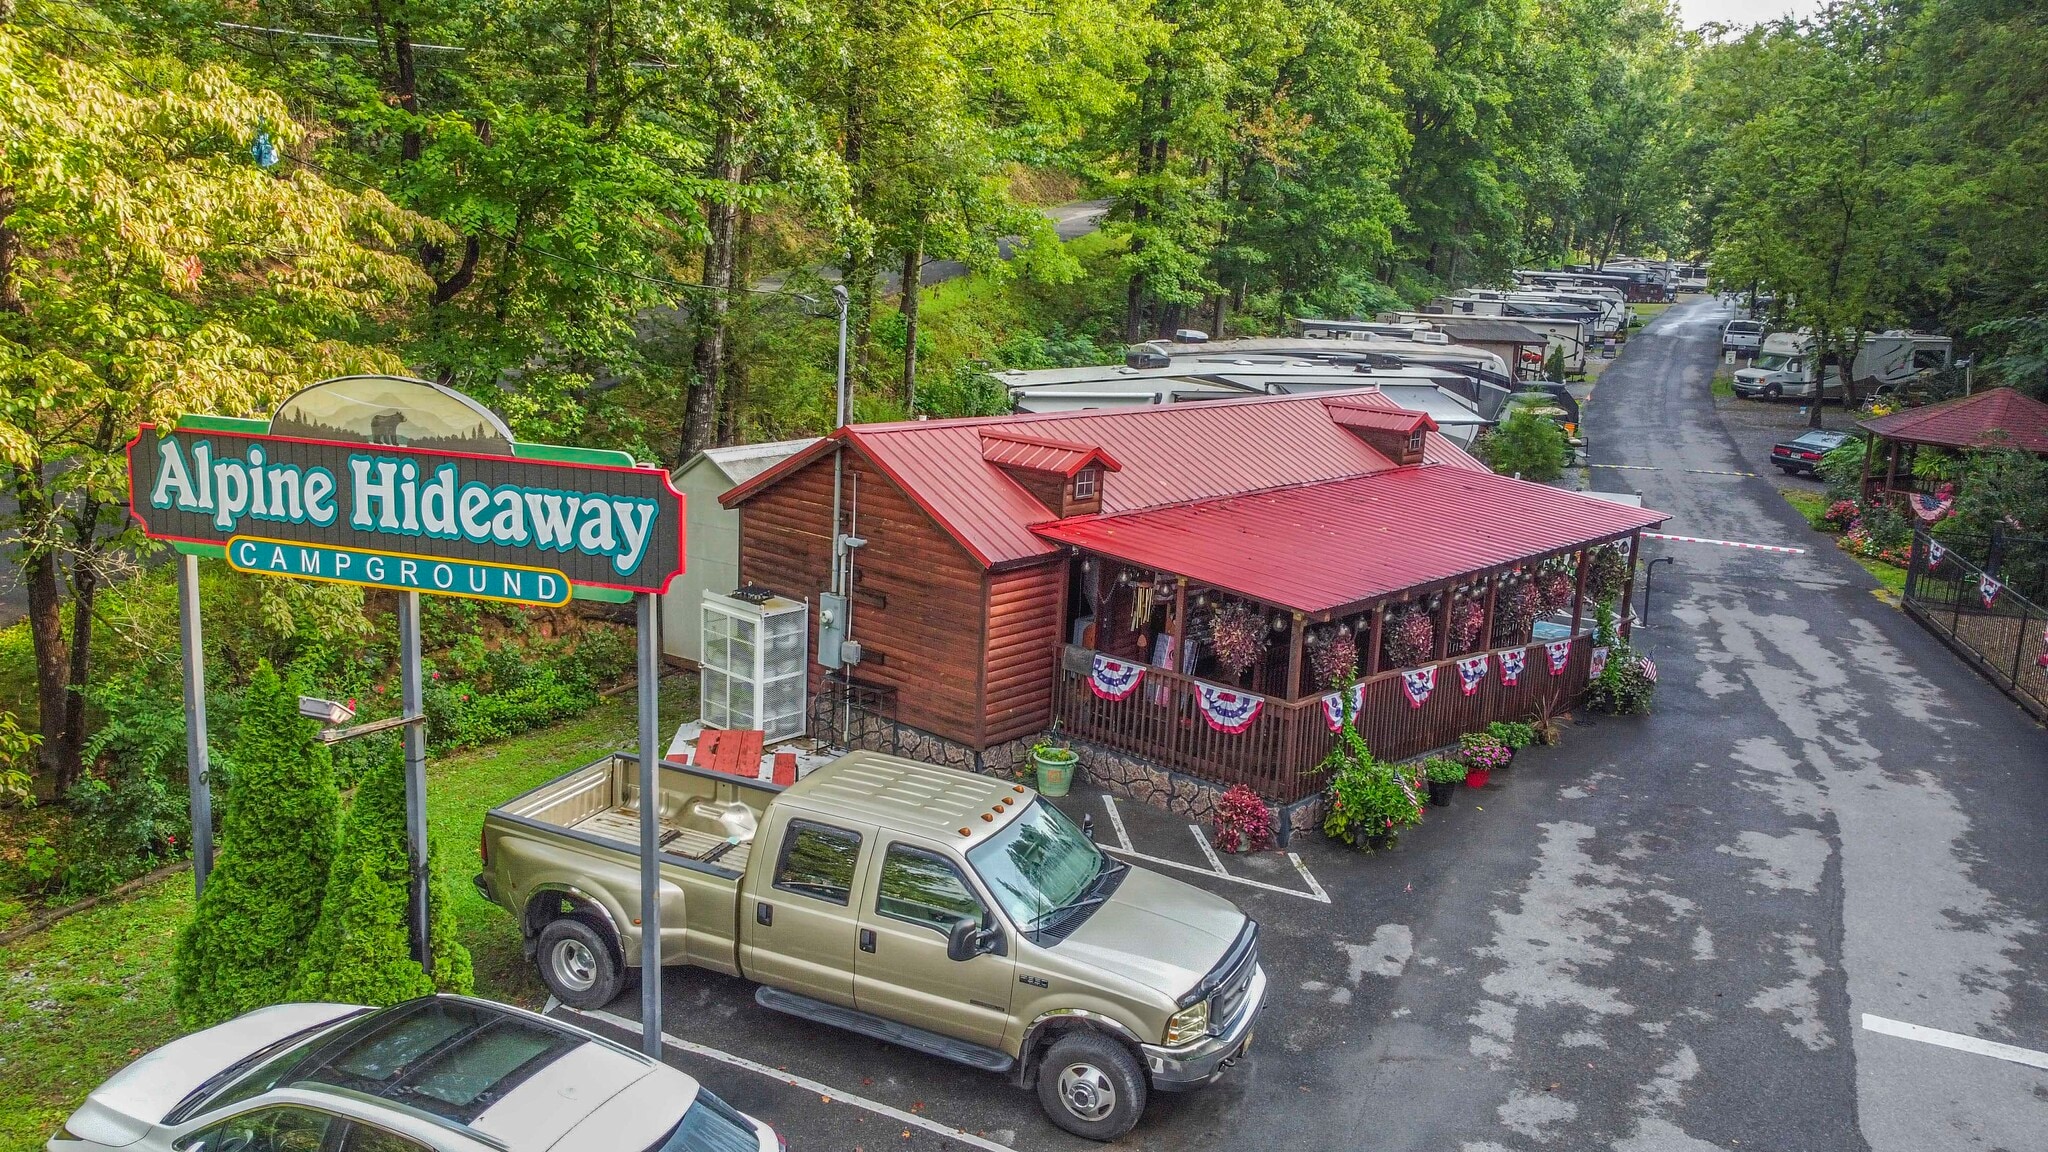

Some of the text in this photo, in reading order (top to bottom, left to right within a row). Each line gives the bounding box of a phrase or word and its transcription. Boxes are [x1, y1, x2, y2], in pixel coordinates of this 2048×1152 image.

[152, 438, 656, 572] Alpine Hideaway
[239, 541, 558, 601] CAMPGROUND
